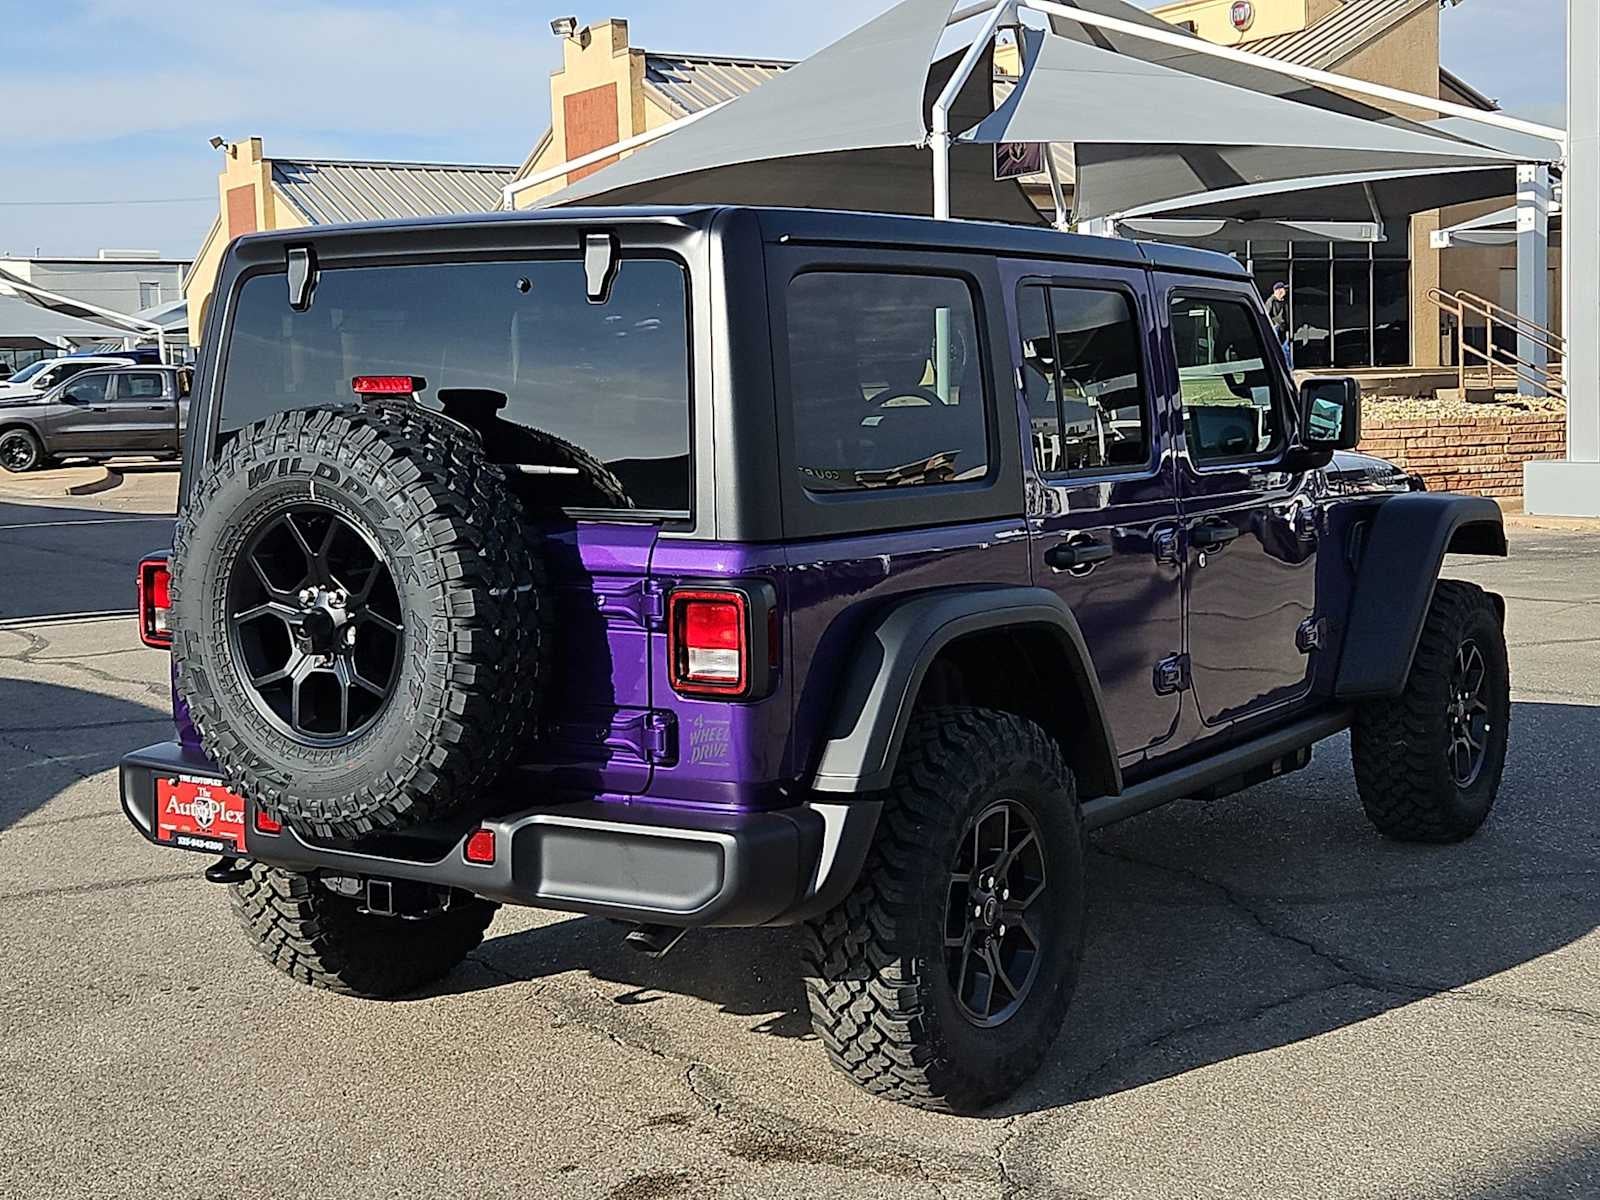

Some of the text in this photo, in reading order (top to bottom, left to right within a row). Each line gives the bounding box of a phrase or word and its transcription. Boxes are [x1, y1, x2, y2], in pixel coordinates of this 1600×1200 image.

[248, 457, 421, 587] WILDPEAK
[694, 713, 704, 728] 4
[690, 727, 730, 746] WHEEL
[690, 743, 729, 764] DRIVE
[197, 787, 213, 798] The
